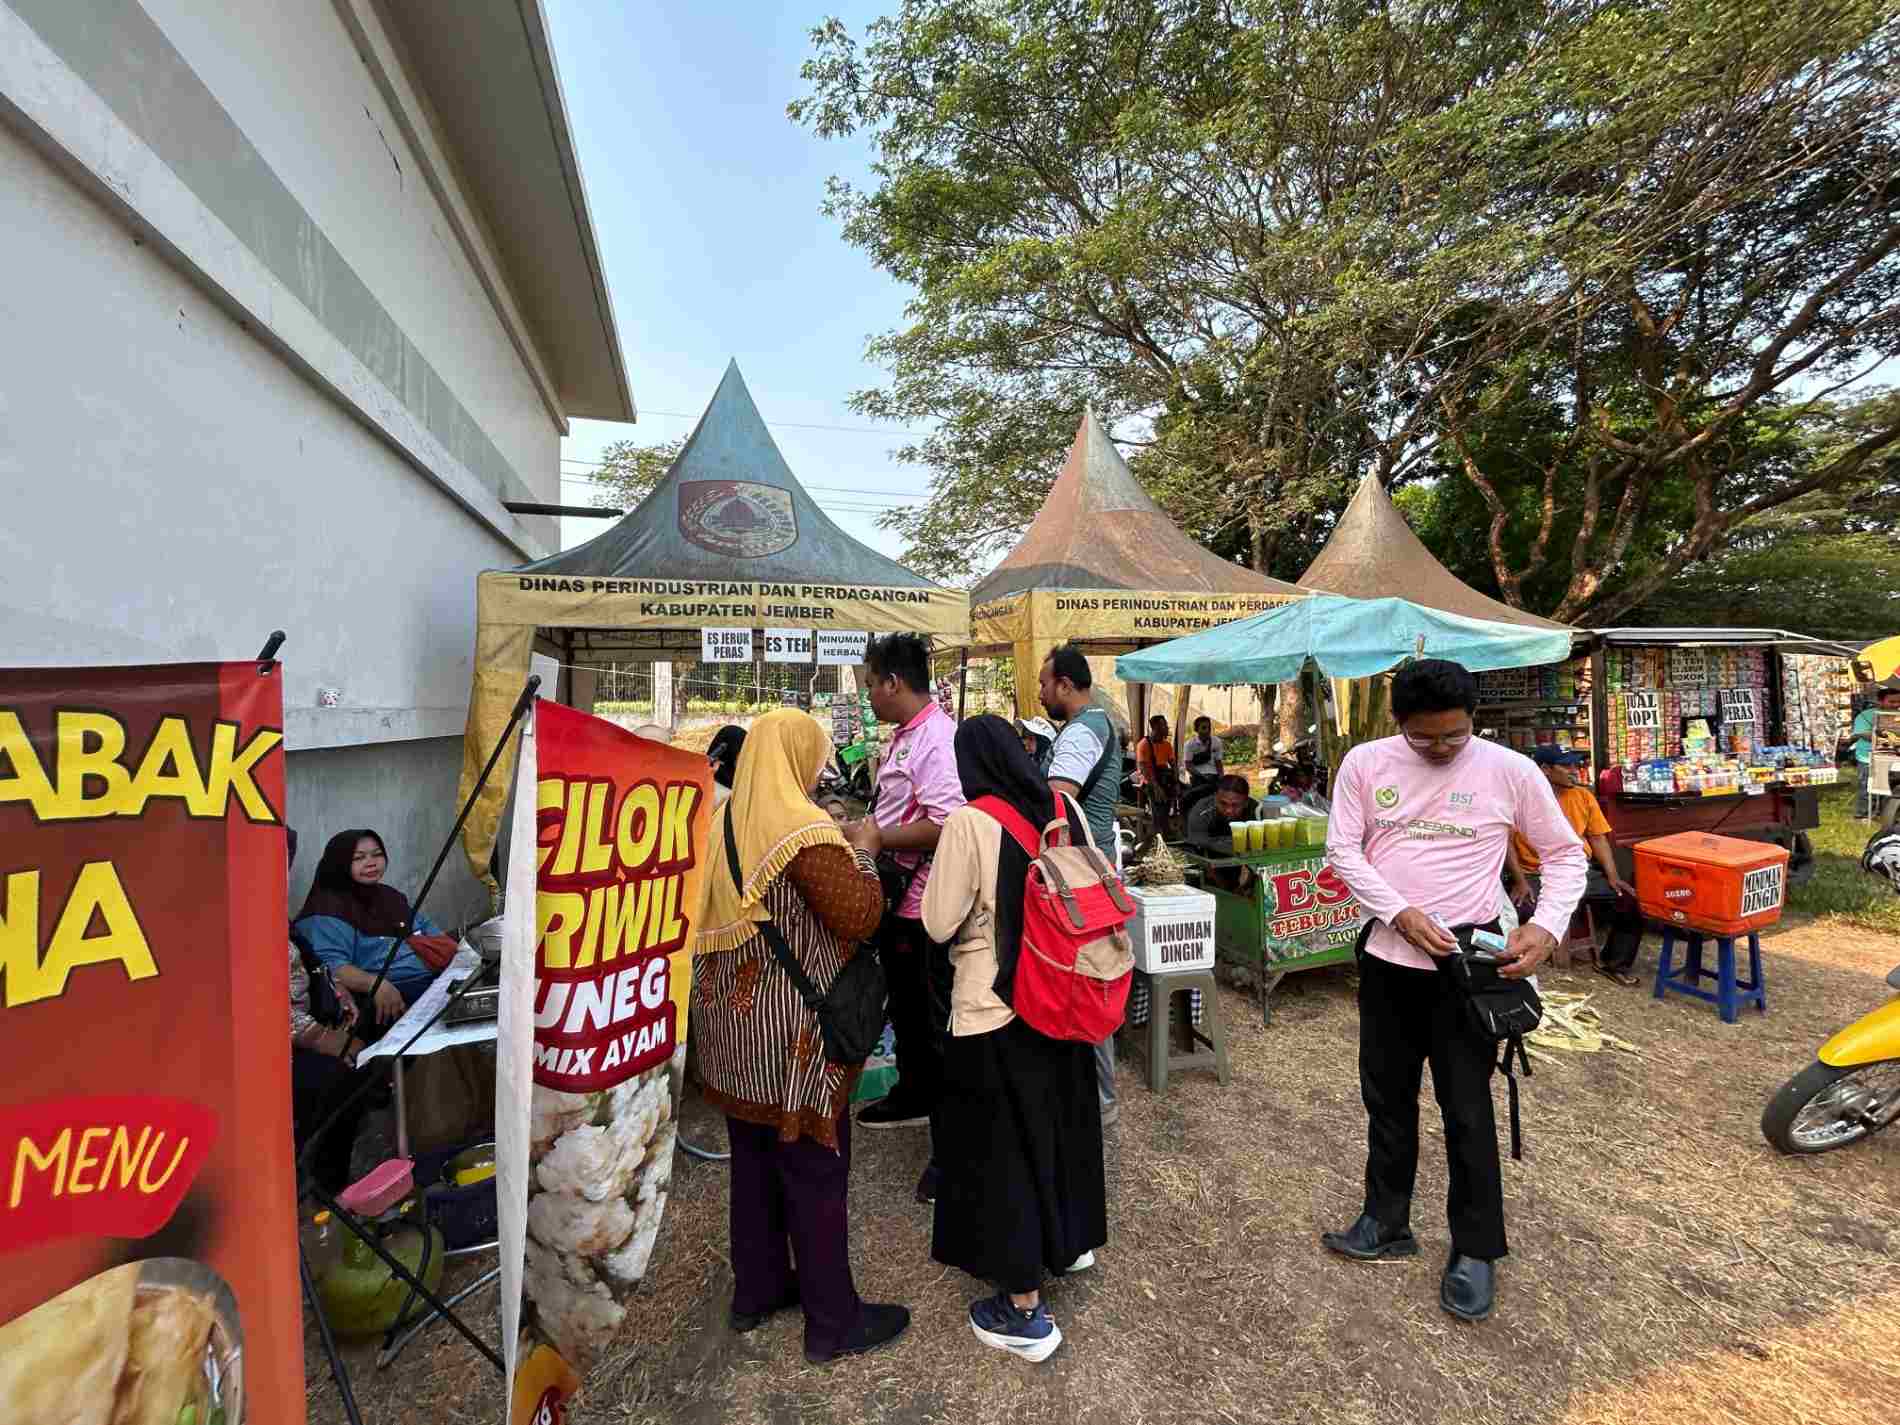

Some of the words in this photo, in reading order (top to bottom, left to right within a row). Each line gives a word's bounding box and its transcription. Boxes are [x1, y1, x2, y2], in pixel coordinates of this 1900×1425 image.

[519, 577, 585, 592] DINAS
[591, 580, 752, 597] PERINDUSTRIAN
[759, 584, 796, 597] DAN
[801, 586, 929, 603] PERDAGANGAN
[640, 602, 756, 617] KABUPATEN
[763, 605, 834, 619] JEMBER
[1056, 598, 1099, 610] DINAS
[1102, 599, 1207, 611] PERINDUSTRIAN
[1211, 600, 1235, 610] DAN
[1134, 616, 1210, 628] KABUPATEN
[707, 632, 719, 645] ES
[721, 632, 750, 645] JERUK
[766, 637, 782, 652] ES
[786, 637, 811, 653] TEH
[818, 635, 866, 644] MINUMAN
[713, 646, 744, 659] PERAS
[823, 649, 862, 657] HERBAL
[1152, 921, 1211, 944] MINUMAN
[1161, 941, 1203, 963] DINGIN
[600, 1016, 666, 1072] AYAM
[10, 1125, 190, 1208] MENU
